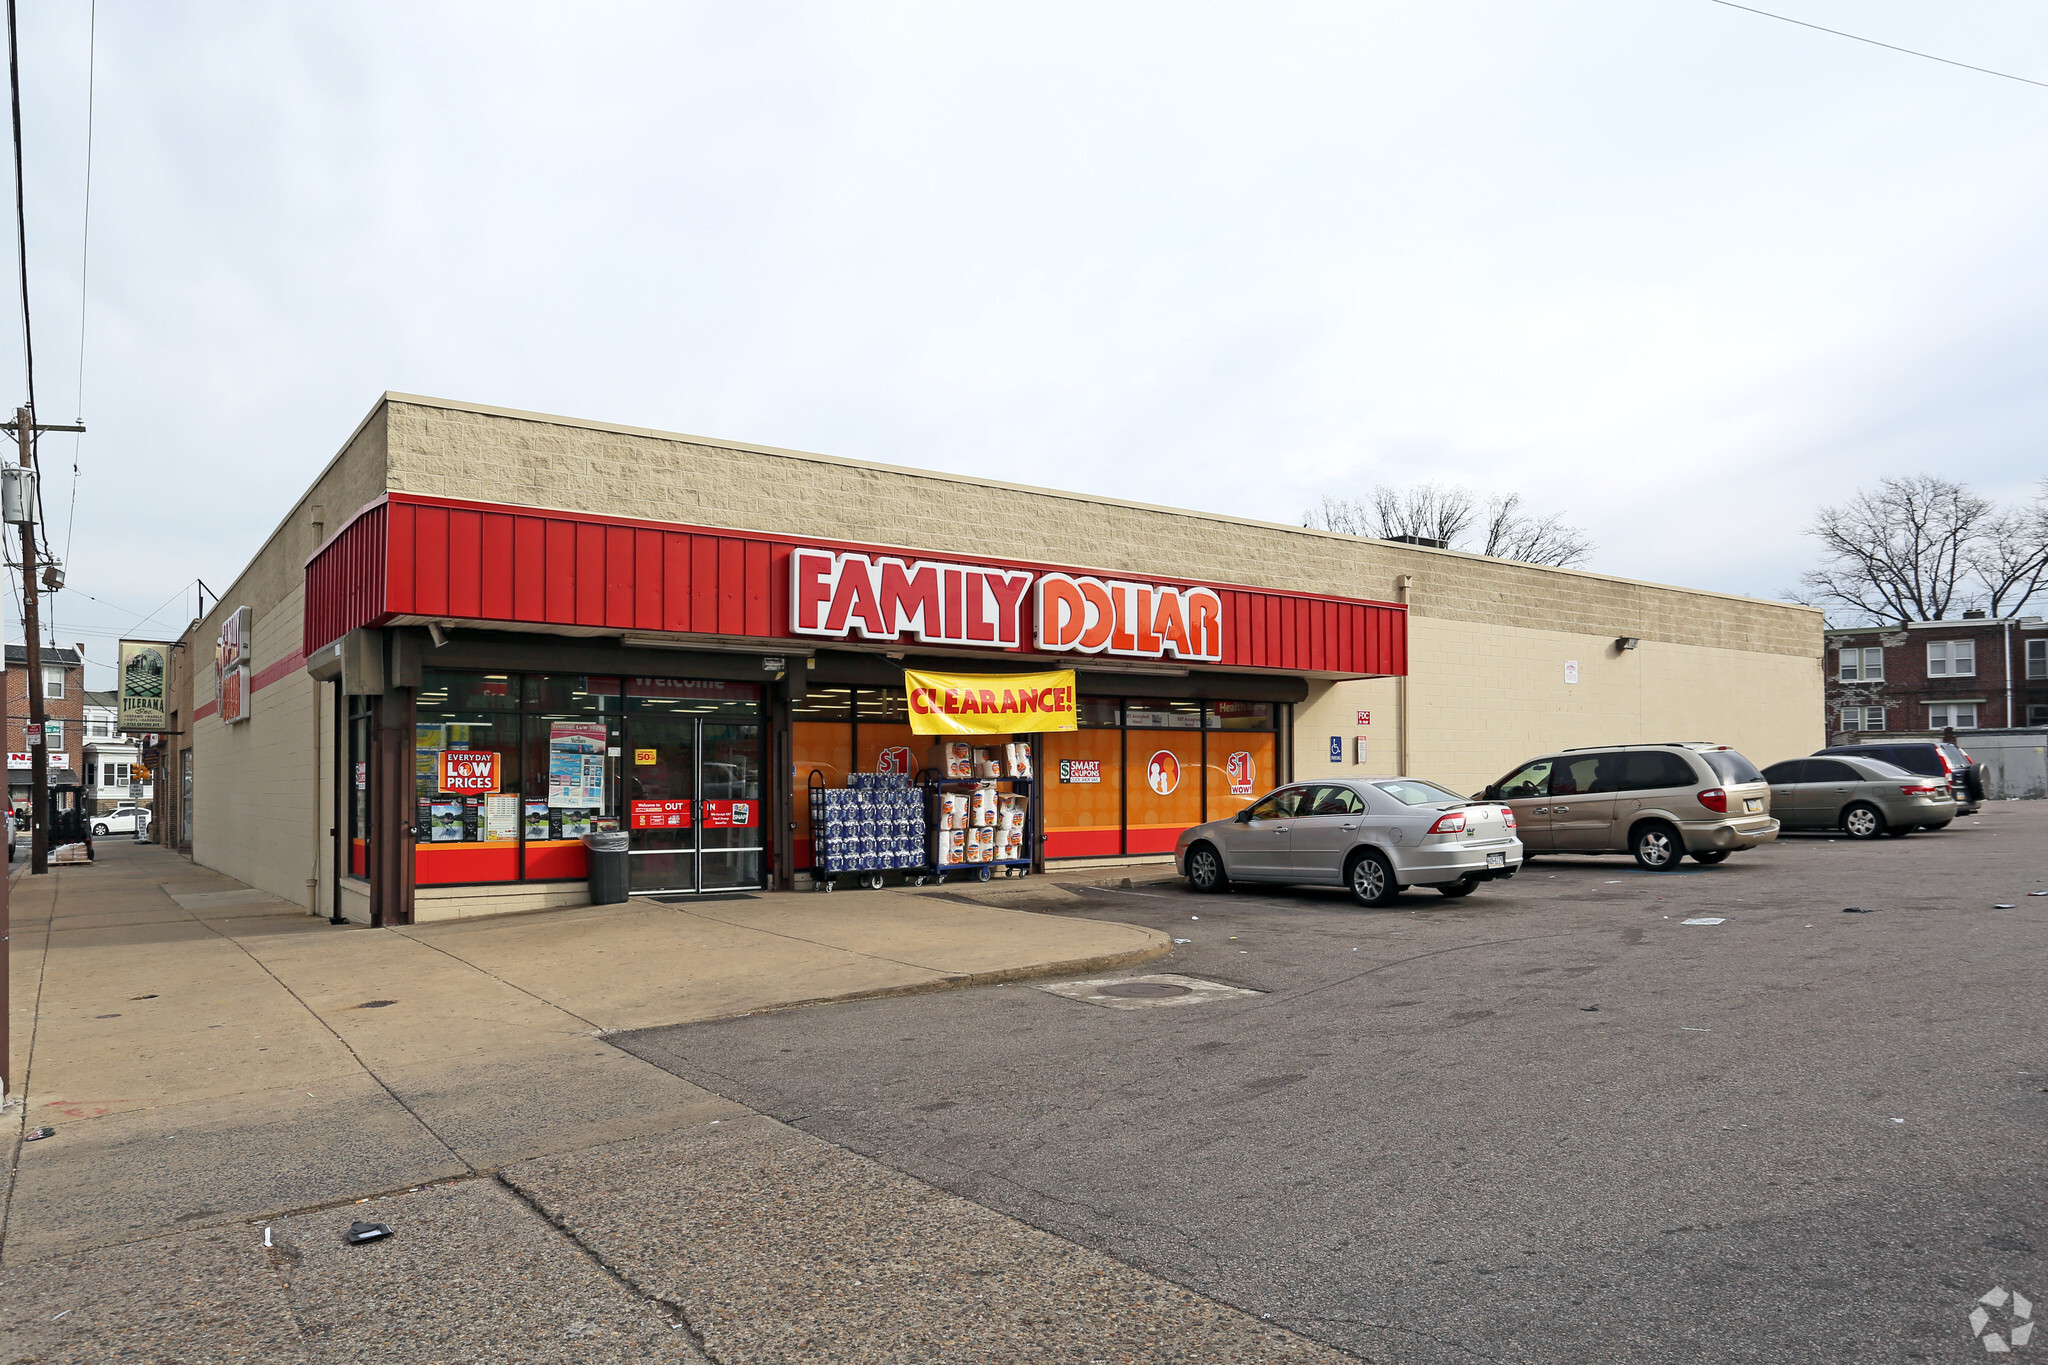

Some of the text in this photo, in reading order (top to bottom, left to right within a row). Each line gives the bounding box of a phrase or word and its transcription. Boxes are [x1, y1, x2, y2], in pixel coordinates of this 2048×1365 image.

[798, 553, 1219, 657] FAMILY DOLLAR
[910, 685, 1073, 715] CLEARANCE!
[123, 698, 164, 714] TILERAMA
[1358, 712, 1369, 720] FDC
[447, 761, 492, 777] LOW
[1071, 761, 1099, 770] SMART
[1229, 753, 1251, 785] $1
[1071, 769, 1099, 777] COUPONS
[447, 777, 492, 788] PRICES
[1231, 786, 1252, 794] WOW!
[706, 803, 716, 811] IN
